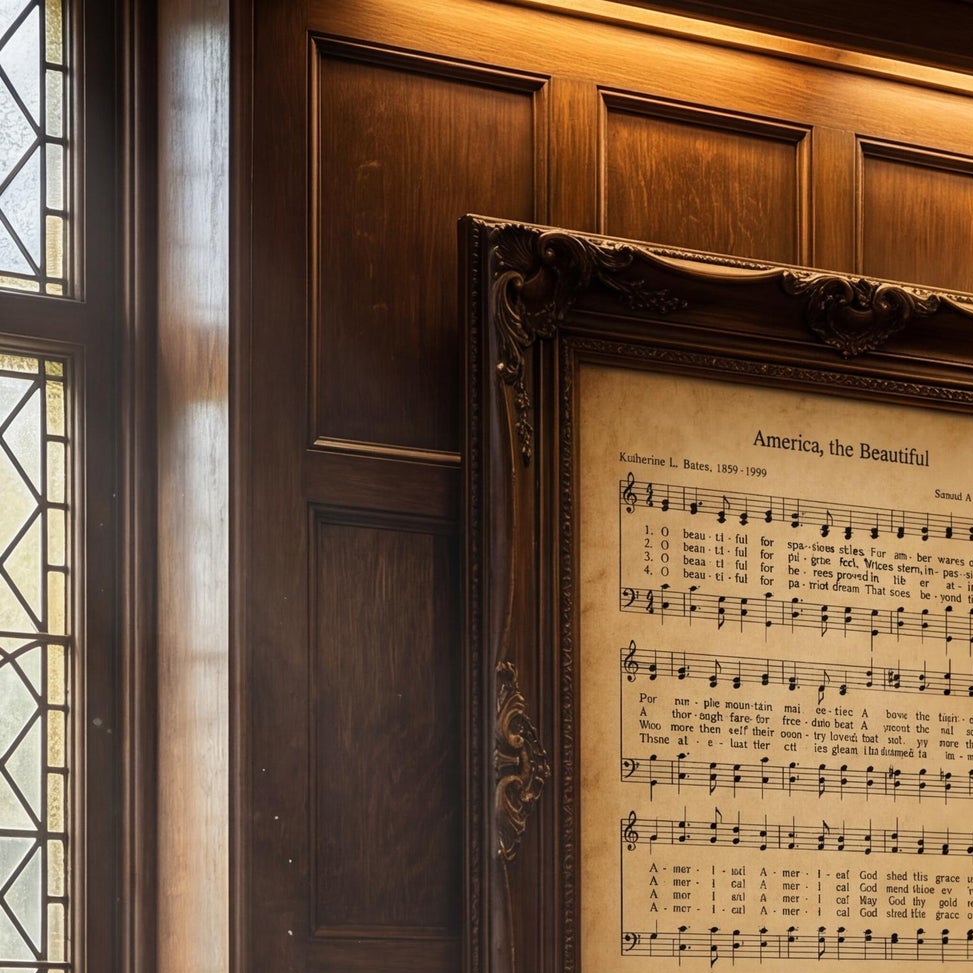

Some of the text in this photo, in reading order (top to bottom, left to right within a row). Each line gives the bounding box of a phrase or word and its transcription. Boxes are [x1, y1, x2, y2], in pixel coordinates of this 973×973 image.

[753, 430, 929, 467] America, the Beautiful
[645, 538, 652, 548] 2.
[661, 540, 669, 550] O
[735, 547, 747, 557] ful
[760, 549, 774, 559] for
[646, 525, 653, 535] 1.
[661, 526, 669, 537] O
[683, 529, 705, 540] beau
[735, 534, 748, 544] ful
[761, 536, 774, 547] for
[917, 553, 932, 562] ber
[644, 551, 653, 561] 3.
[661, 553, 669, 563] O
[735, 560, 747, 570] ful
[760, 562, 774, 573] for
[644, 565, 652, 575] 4.
[661, 567, 669, 576] O
[683, 568, 705, 579] beau
[735, 573, 748, 583] ful
[760, 575, 774, 586] for
[865, 584, 885, 595] That
[920, 590, 931, 600] be
[940, 594, 962, 603] yond
[640, 707, 647, 716] A
[672, 709, 692, 719] thor
[861, 721, 868, 730] A
[649, 863, 658, 873] A
[760, 868, 767, 876] A
[860, 871, 877, 880] God
[887, 871, 907, 881] shed
[935, 875, 960, 884] grace
[649, 876, 658, 886] A
[760, 880, 767, 889] A
[860, 883, 877, 892] God
[650, 889, 658, 899] A
[760, 894, 767, 902] A
[888, 896, 905, 905] God
[939, 898, 957, 909] gold
[650, 902, 658, 912] A
[760, 906, 767, 915] A
[783, 908, 800, 916] mer
[860, 908, 877, 917] God
